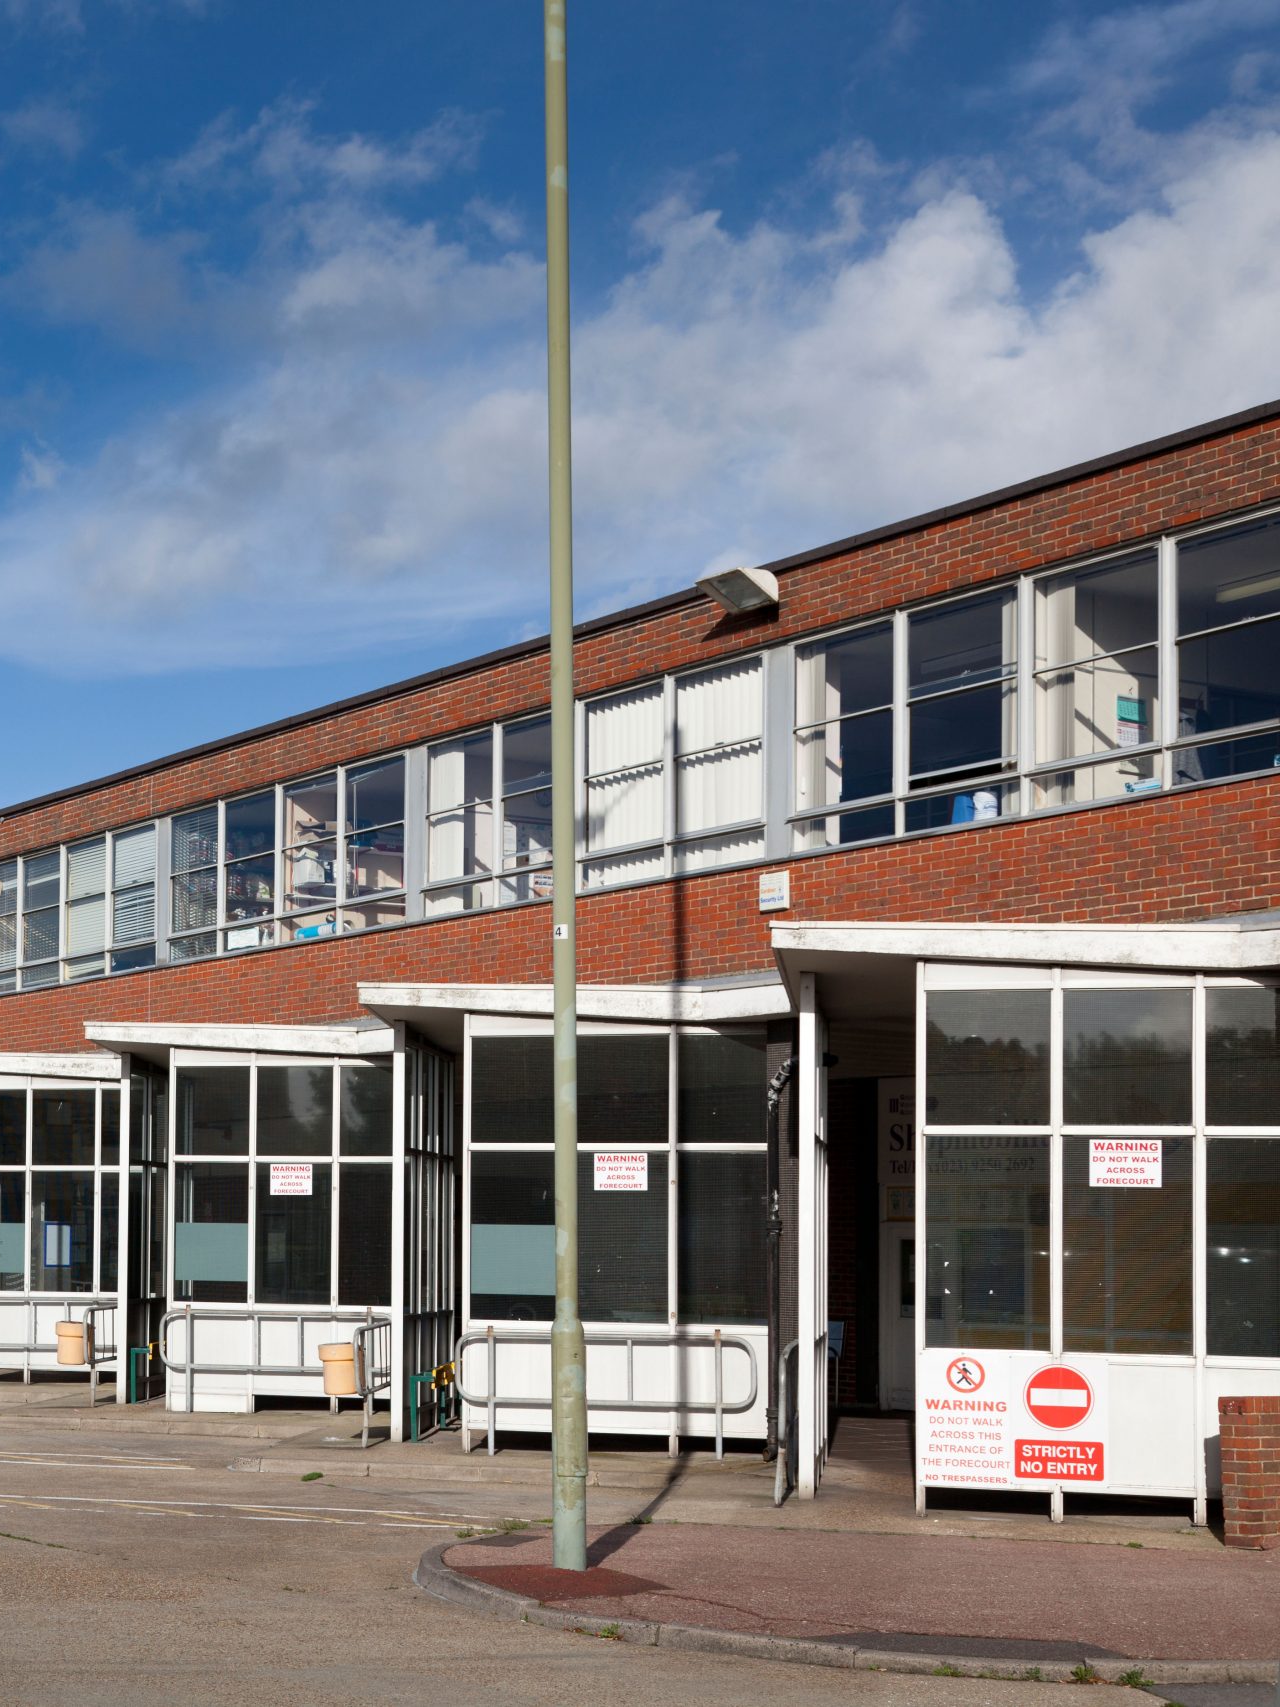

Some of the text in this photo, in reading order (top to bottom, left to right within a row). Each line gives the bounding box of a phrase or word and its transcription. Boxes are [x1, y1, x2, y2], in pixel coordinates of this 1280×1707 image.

[555, 926, 563, 937] 4
[1093, 1142, 1158, 1151] WARNING
[1005, 1156, 1036, 1171] 2692
[1092, 1155, 1106, 1163] DO
[1096, 1177, 1155, 1185] FORECOURT
[925, 1398, 1008, 1412] WARNING
[929, 1415, 1003, 1427] DO NOT WALK
[930, 1430, 1002, 1441] ACROSS THIS
[928, 1443, 1004, 1455] ENTRANCE OF
[1022, 1444, 1096, 1460] STRICTLY
[921, 1457, 1011, 1470] THE FORECOURT
[1020, 1461, 1098, 1476] NO ENTRY
[925, 1473, 1008, 1484] NO TRESPASSERS
